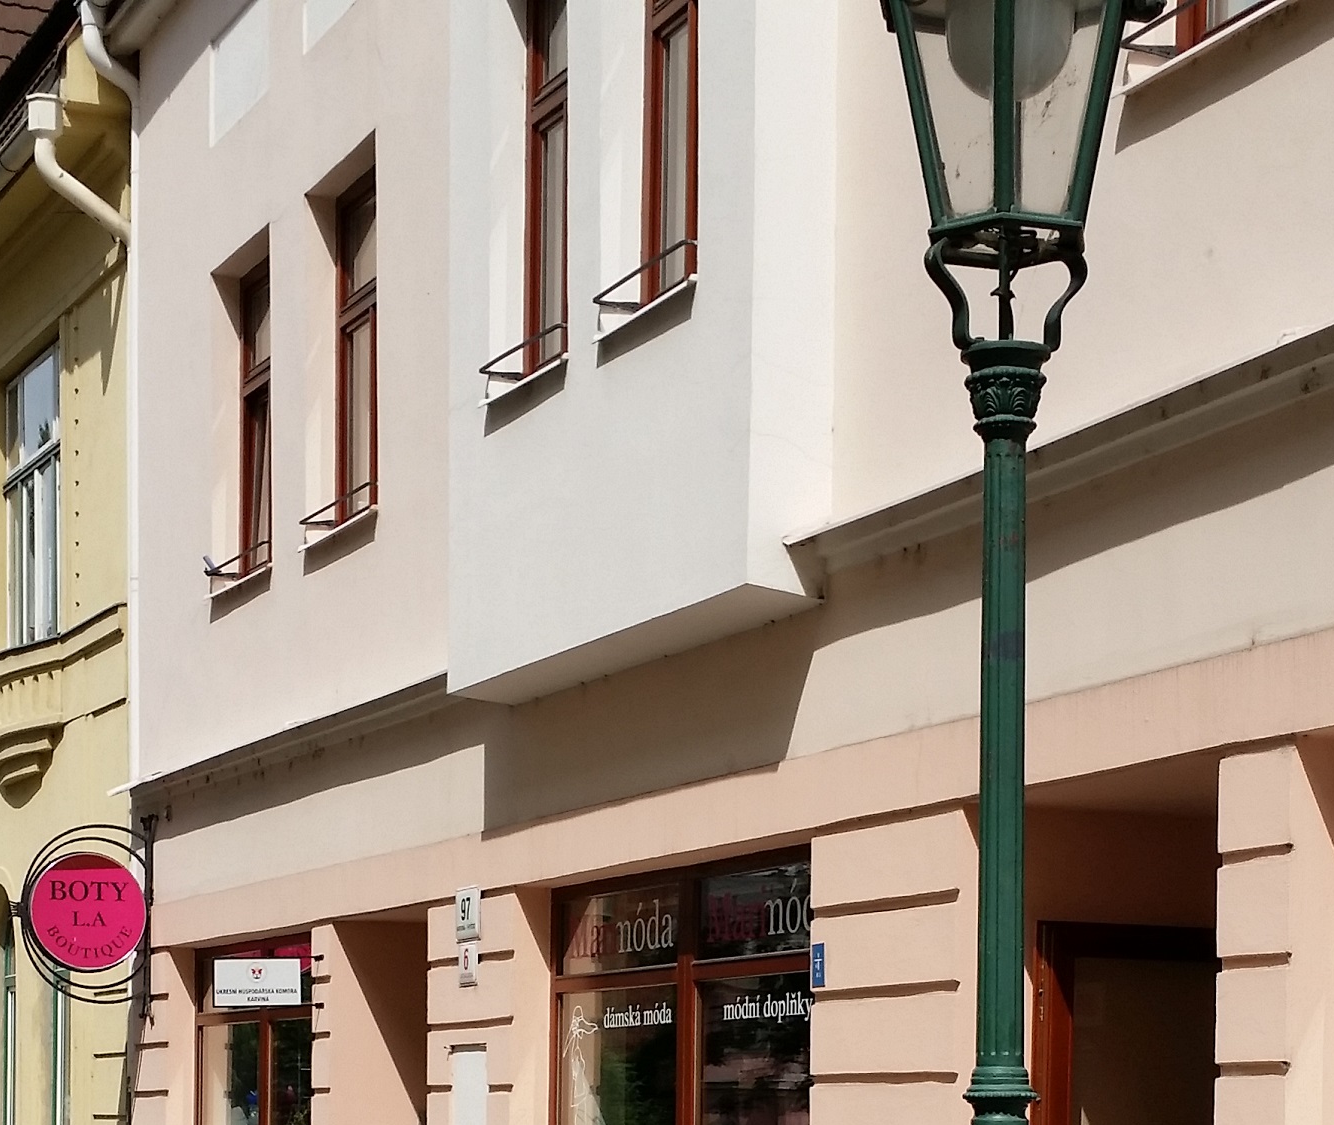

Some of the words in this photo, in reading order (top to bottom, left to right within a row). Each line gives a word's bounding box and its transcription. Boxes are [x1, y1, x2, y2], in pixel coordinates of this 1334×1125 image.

[49, 879, 129, 902] BOTY
[71, 910, 108, 928] L.A
[460, 896, 471, 921] 97
[46, 924, 133, 960] BOUTIQUE
[464, 948, 469, 970] 6
[603, 1003, 642, 1029] dámská
[642, 1001, 673, 1026] móda
[722, 994, 761, 1021] módní
[763, 991, 814, 1024] doplňky
